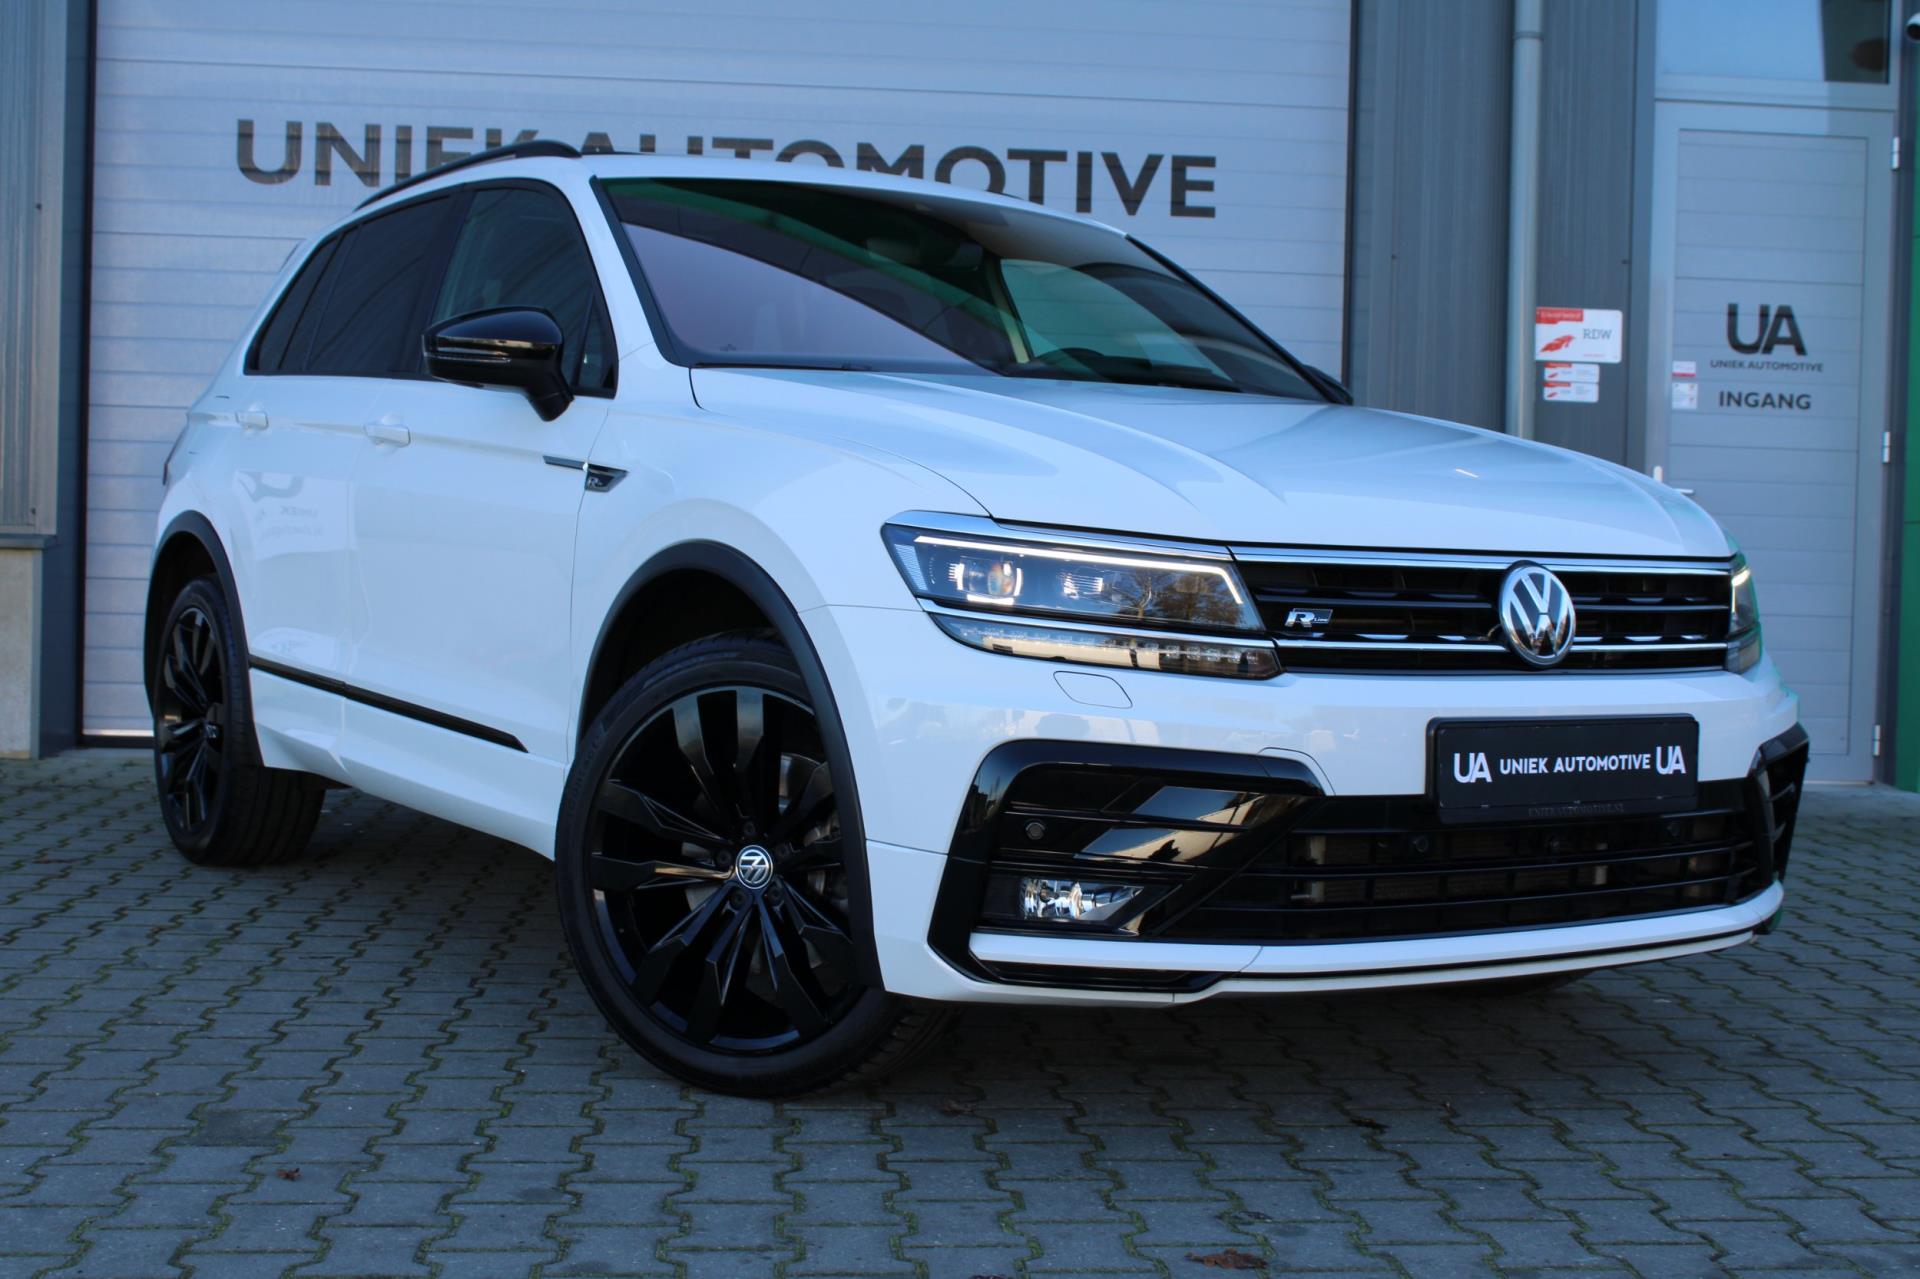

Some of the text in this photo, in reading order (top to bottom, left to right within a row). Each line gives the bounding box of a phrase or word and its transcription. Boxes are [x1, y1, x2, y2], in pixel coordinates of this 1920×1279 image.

[1583, 329, 1612, 340] RDW
[1727, 303, 1807, 356] UA
[1710, 360, 1824, 372] UNIEK AUTOMOTIVE
[1719, 391, 1811, 410] INGANG
[1453, 745, 1687, 783] UA UNIEK AUTOMOTIVE UA
